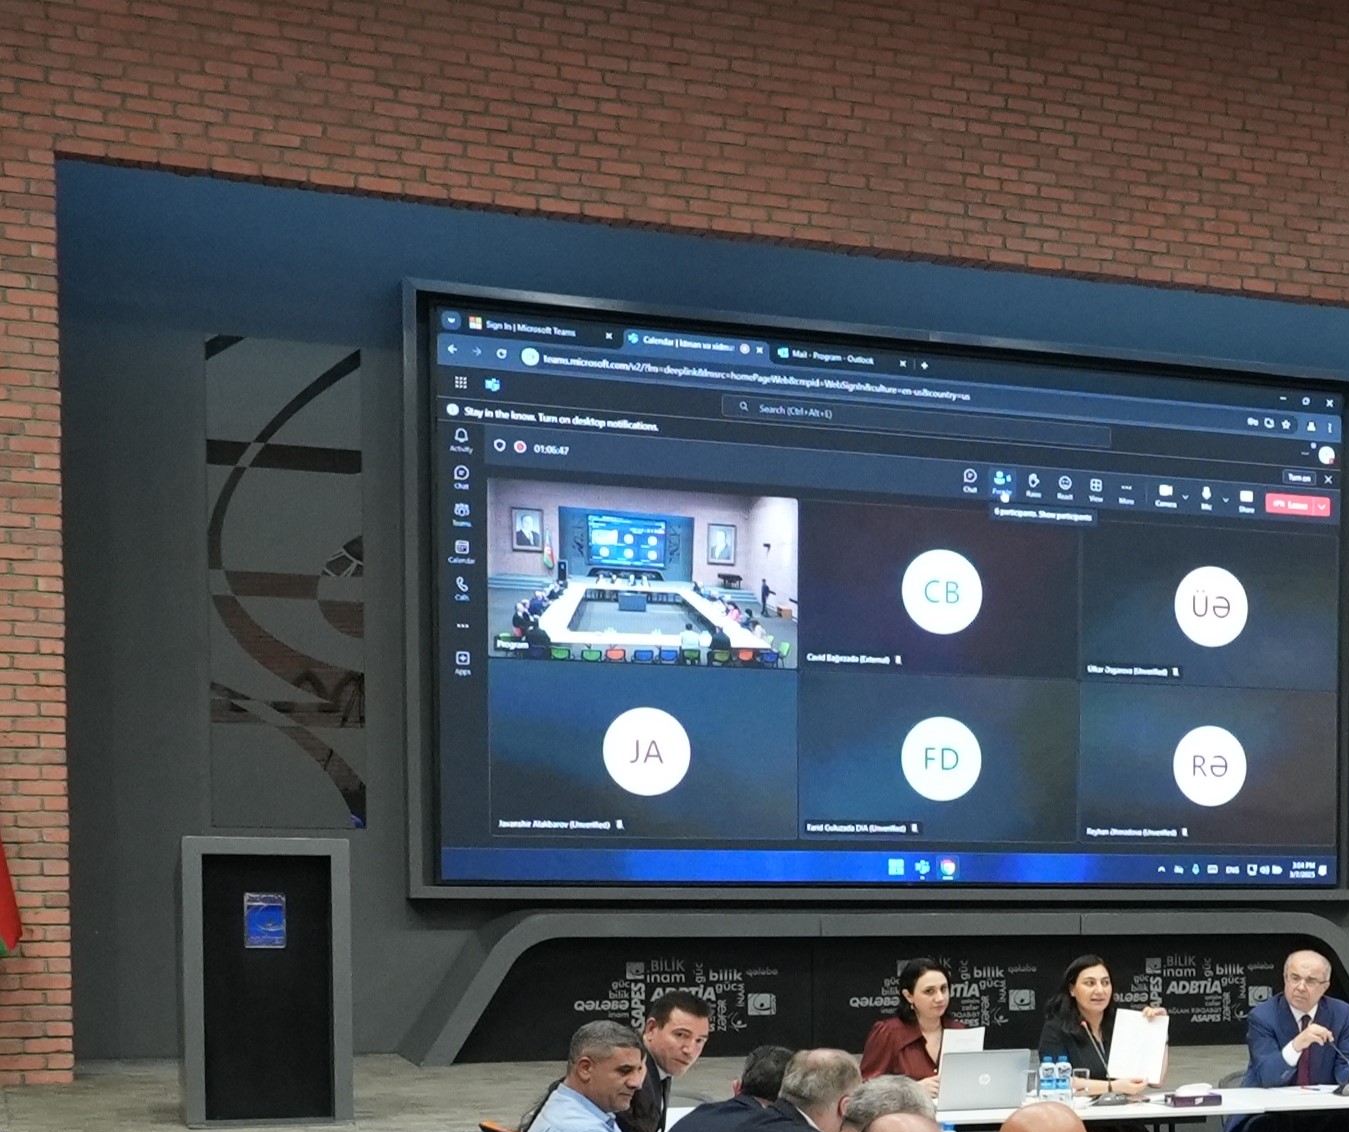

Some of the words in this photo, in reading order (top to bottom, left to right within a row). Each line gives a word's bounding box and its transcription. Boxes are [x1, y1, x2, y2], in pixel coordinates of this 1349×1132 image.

[486, 320, 504, 331] Sign
[517, 323, 552, 335] Microsoft
[553, 327, 576, 337] Teams
[643, 335, 674, 347] Calendar
[792, 349, 808, 359] Mail
[813, 351, 842, 363] Program
[847, 355, 875, 365] Outlook
[760, 405, 786, 416] Search
[464, 406, 483, 420] Stay
[485, 408, 493, 418] in
[495, 409, 509, 419] the
[511, 410, 537, 422] know.
[538, 412, 558, 424] Turn
[559, 416, 571, 425] on
[572, 414, 605, 429] desktop
[606, 417, 659, 432] notifications.
[924, 579, 960, 603] CB
[496, 639, 530, 650] Program
[630, 739, 664, 764] JA
[924, 747, 960, 771] FD
[1192, 754, 1229, 777] RƏ
[1166, 953, 1196, 967] BİLİK
[709, 968, 743, 981] bilik
[973, 966, 1005, 979] bilik
[1163, 964, 1196, 977] inam
[1215, 963, 1244, 975] bilik
[646, 970, 685, 983] inam
[612, 979, 630, 990] güc
[1166, 978, 1222, 995] ADBTİA
[608, 989, 630, 999] bilik
[574, 1000, 630, 1012] QƏLƏBƏ
[631, 982, 646, 1032] SAPES
[1190, 1013, 1221, 1023] ASAPES
